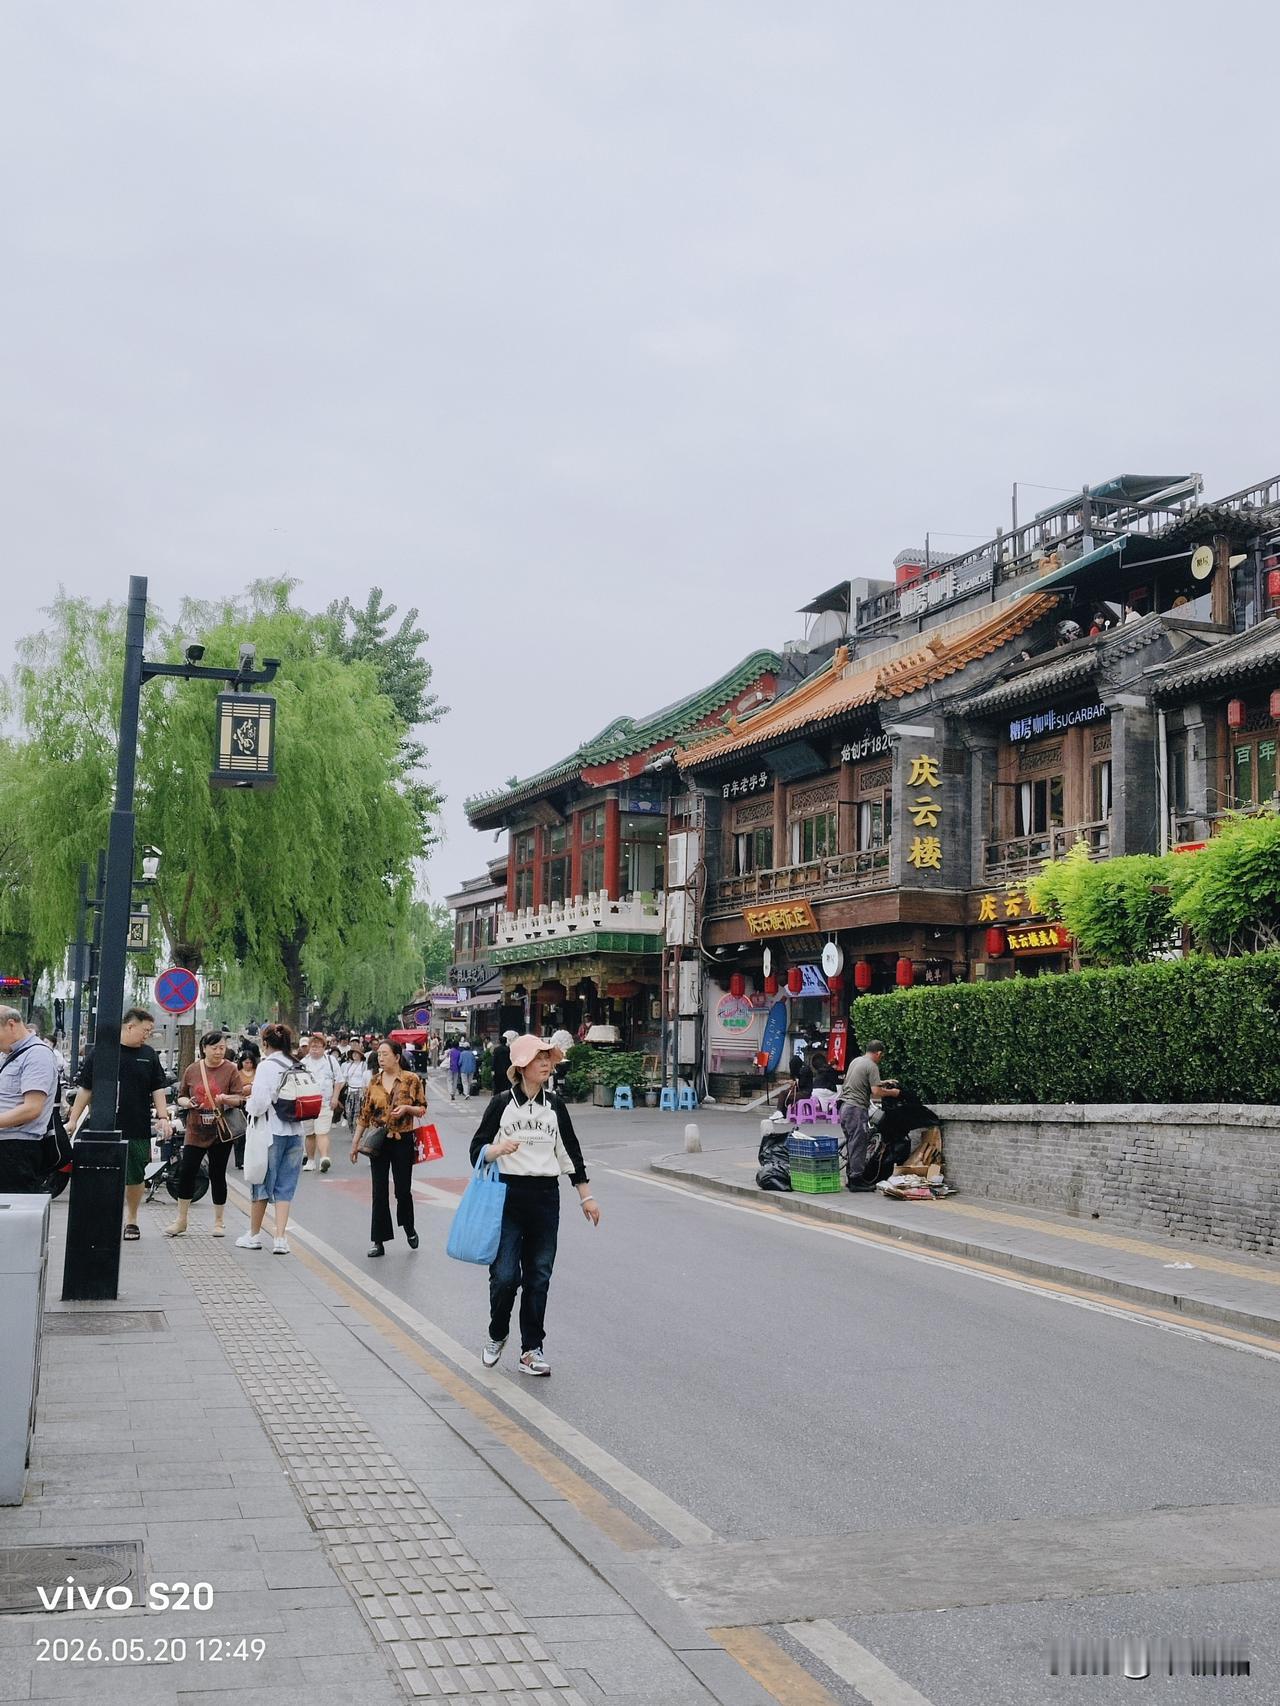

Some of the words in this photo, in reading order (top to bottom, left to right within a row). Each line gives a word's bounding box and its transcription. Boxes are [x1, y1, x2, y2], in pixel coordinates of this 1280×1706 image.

[1056, 703, 1106, 729] SUGARBAR
[1235, 740, 1277, 765] 百年
[722, 770, 768, 799] 百年老字号
[906, 754, 944, 869] 庆云楼
[503, 1119, 555, 1137] CHARM
